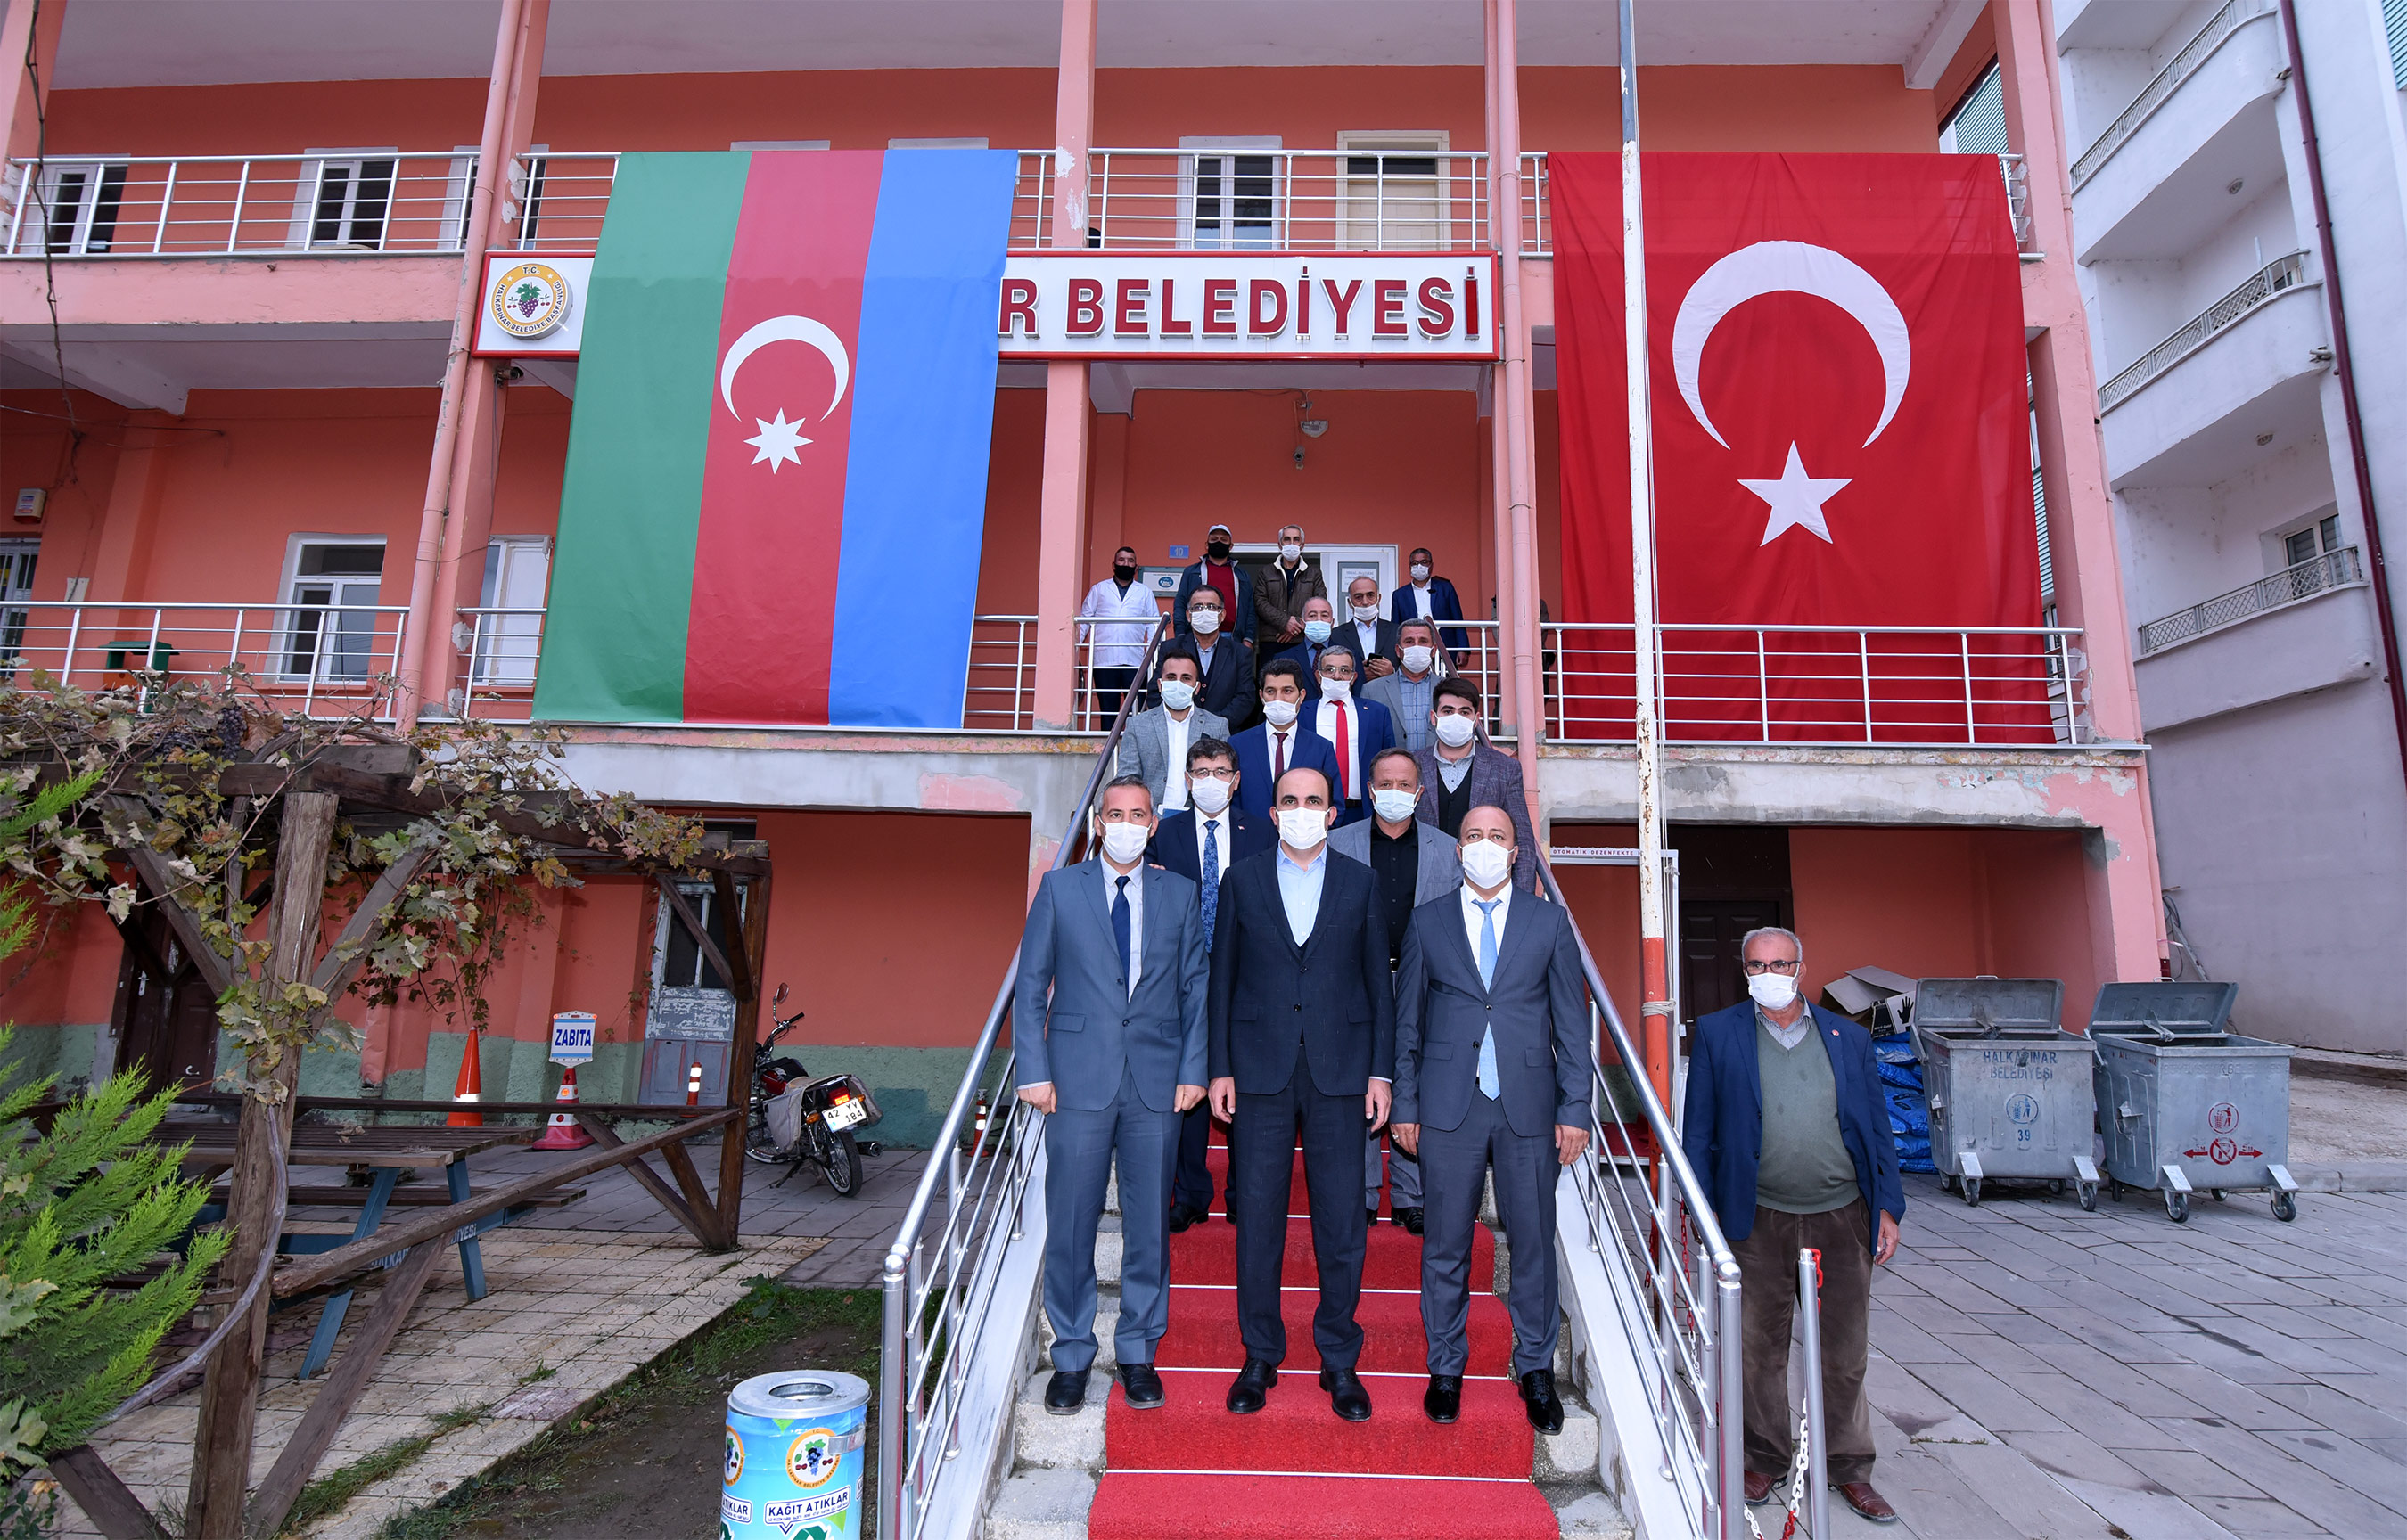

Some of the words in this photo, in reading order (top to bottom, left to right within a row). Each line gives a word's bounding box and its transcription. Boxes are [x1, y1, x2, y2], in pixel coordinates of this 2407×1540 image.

[495, 284, 511, 328] HALKAPINAR
[510, 322, 546, 332] BELEDİYE
[1065, 265, 1480, 340] BELEDİYESİ
[1174, 547, 1184, 557] 10
[555, 1028, 592, 1047] ZABITA
[827, 1109, 840, 1118] 42
[845, 1110, 863, 1123] 184
[2017, 1129, 2031, 1142] 39
[768, 1503, 802, 1517] KAĞIT
[806, 1492, 848, 1512] ATIKLAR
